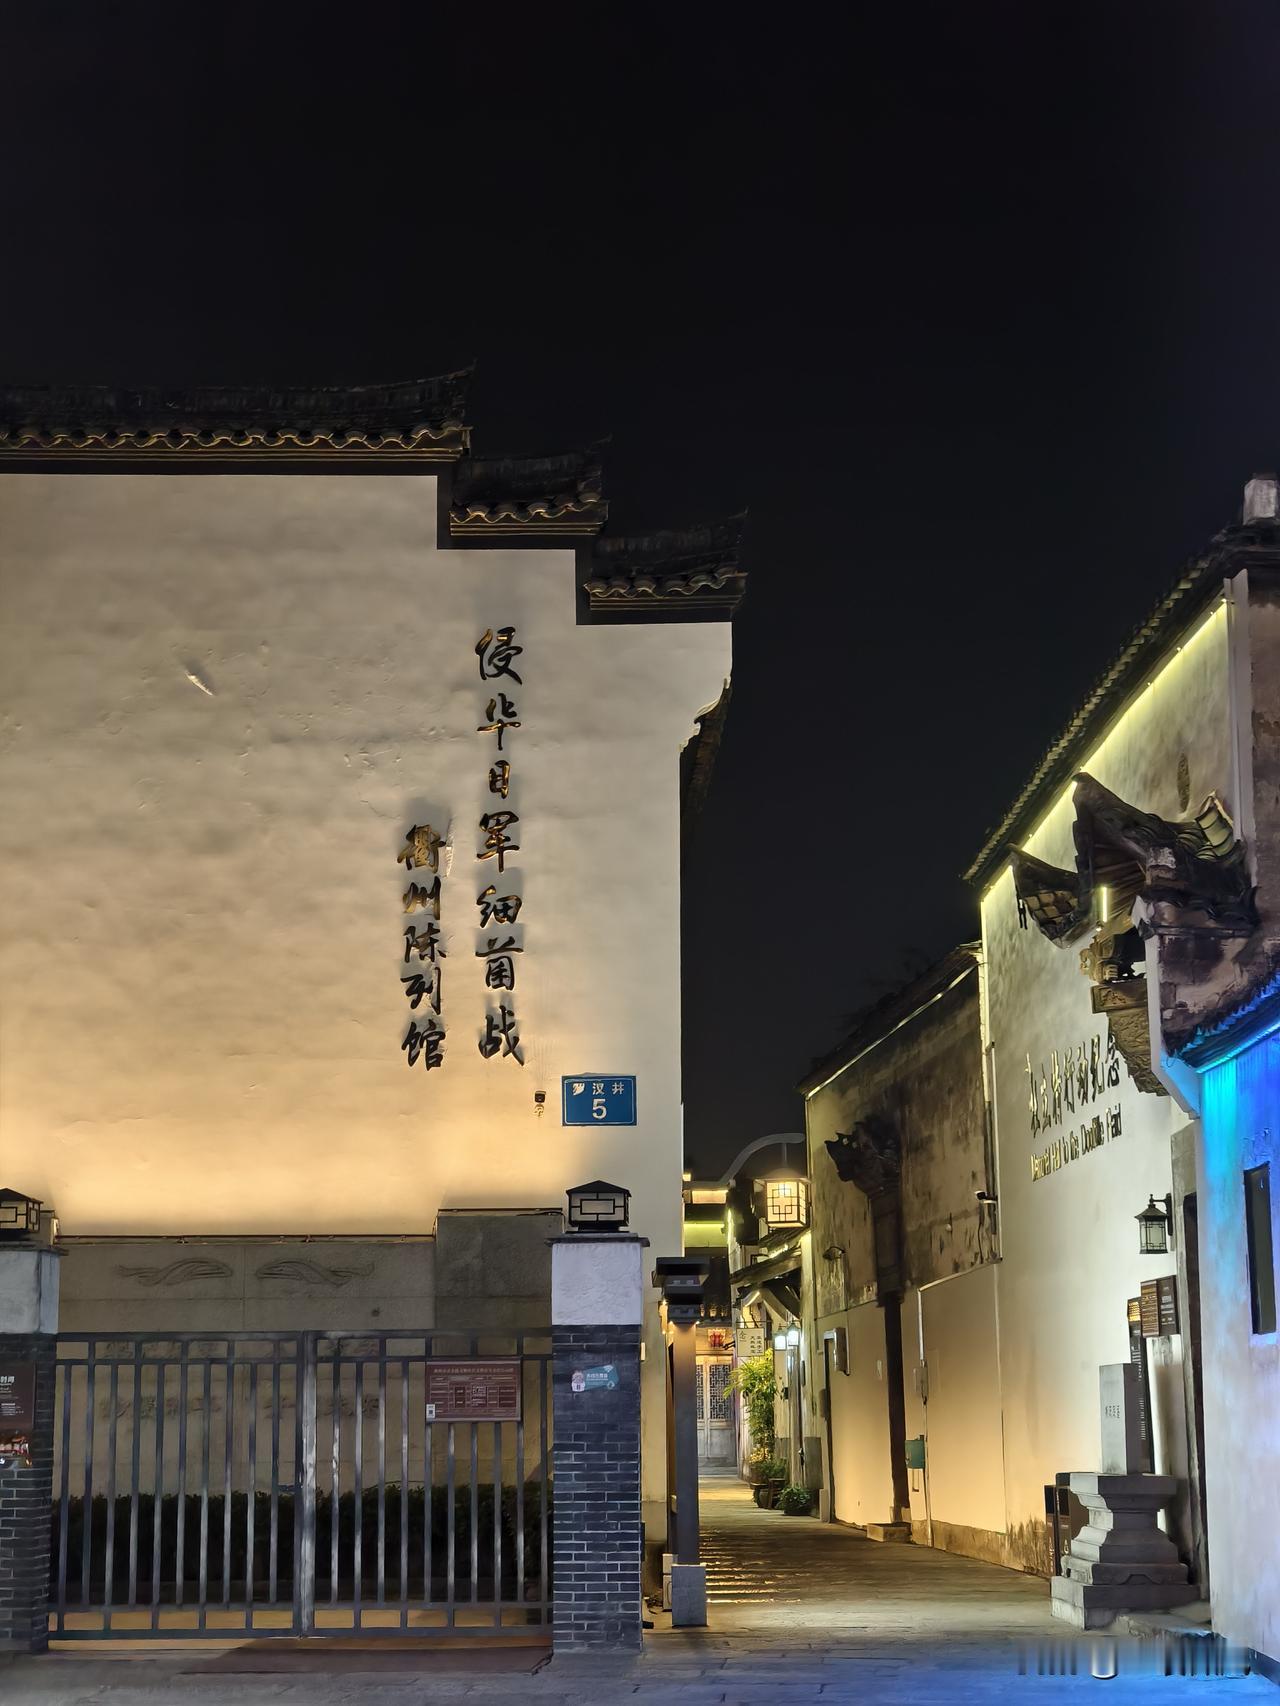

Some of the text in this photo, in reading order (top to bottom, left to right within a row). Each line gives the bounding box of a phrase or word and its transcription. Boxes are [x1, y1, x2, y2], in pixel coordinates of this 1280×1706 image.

[475, 626, 524, 1067] 侵华日军细菌战
[397, 823, 447, 1072] 衢州陈列馆
[572, 1081, 625, 1096] 罗汉井
[592, 1098, 608, 1120] 5
